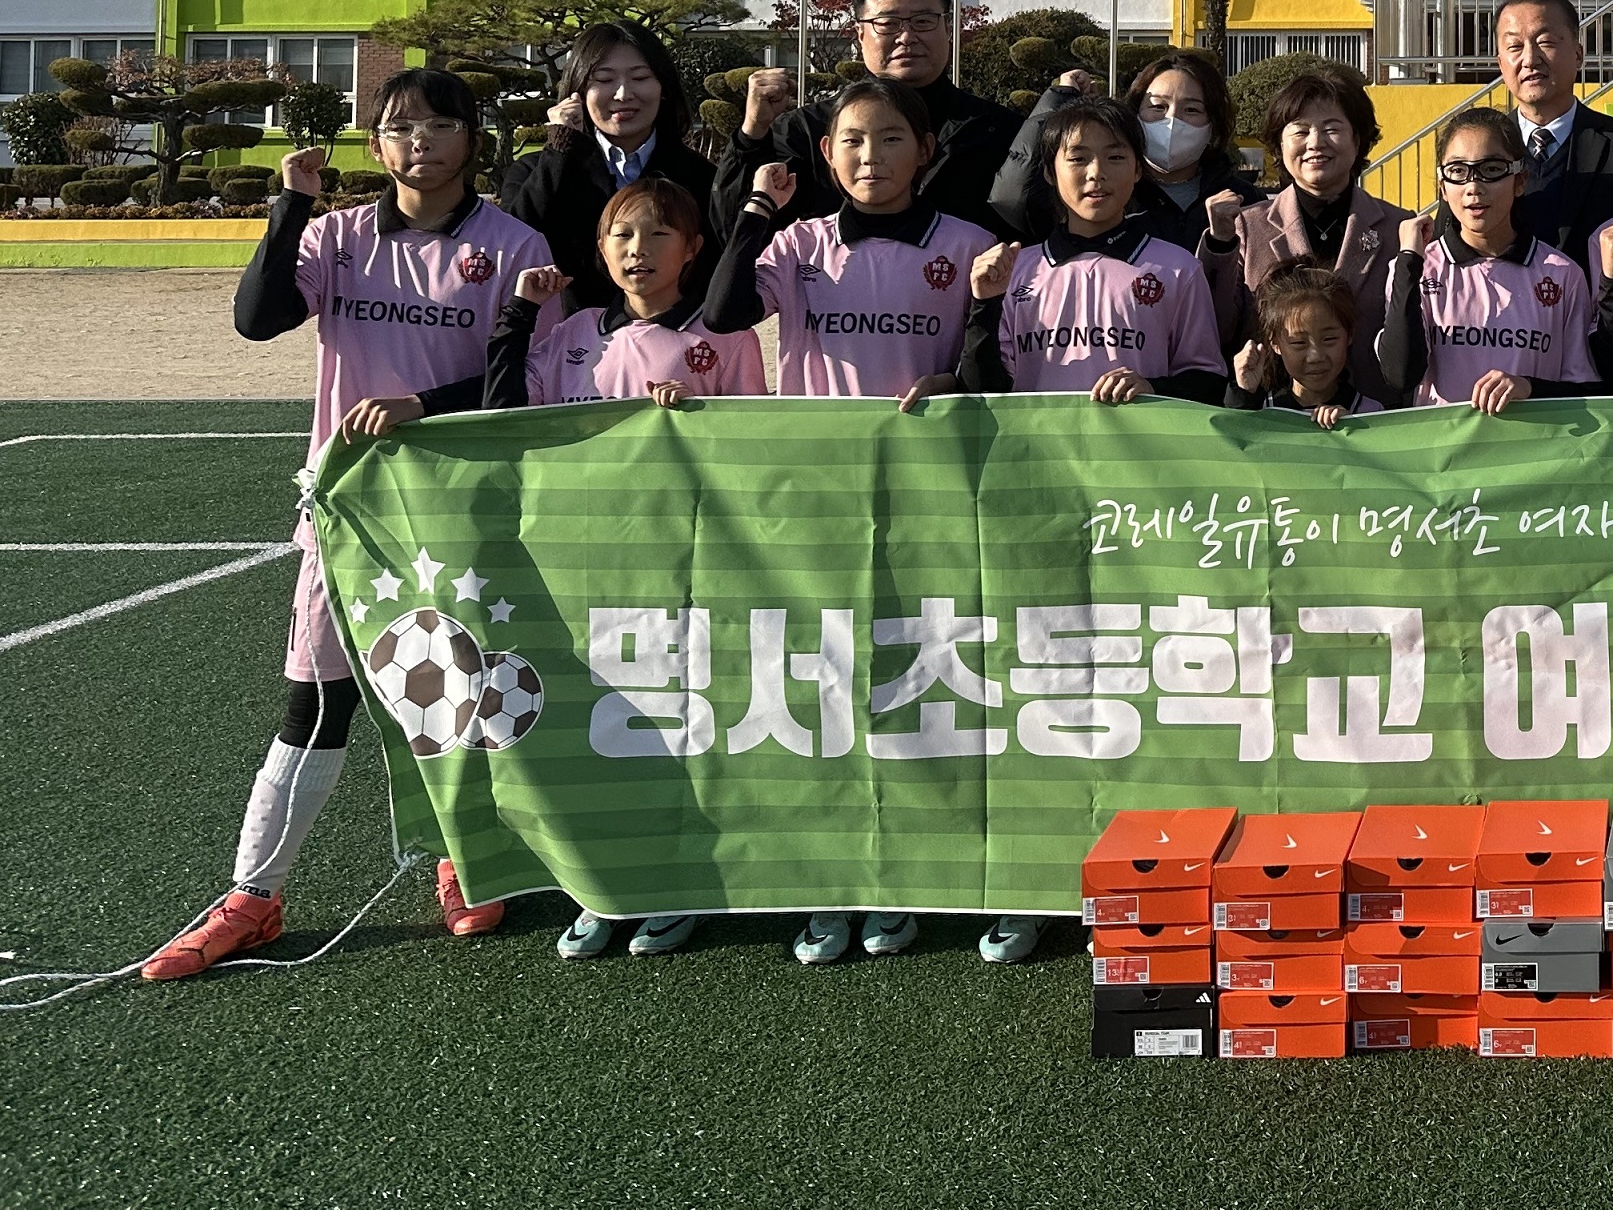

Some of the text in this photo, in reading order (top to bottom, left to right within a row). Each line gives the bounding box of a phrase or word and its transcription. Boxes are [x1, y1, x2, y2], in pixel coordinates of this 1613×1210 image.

[1016, 326, 1146, 355] MYEONGSEO
[1083, 494, 1338, 570] 코레일유통이
[1359, 489, 1500, 557] 명서초
[586, 595, 1433, 764] 명서초등학교
